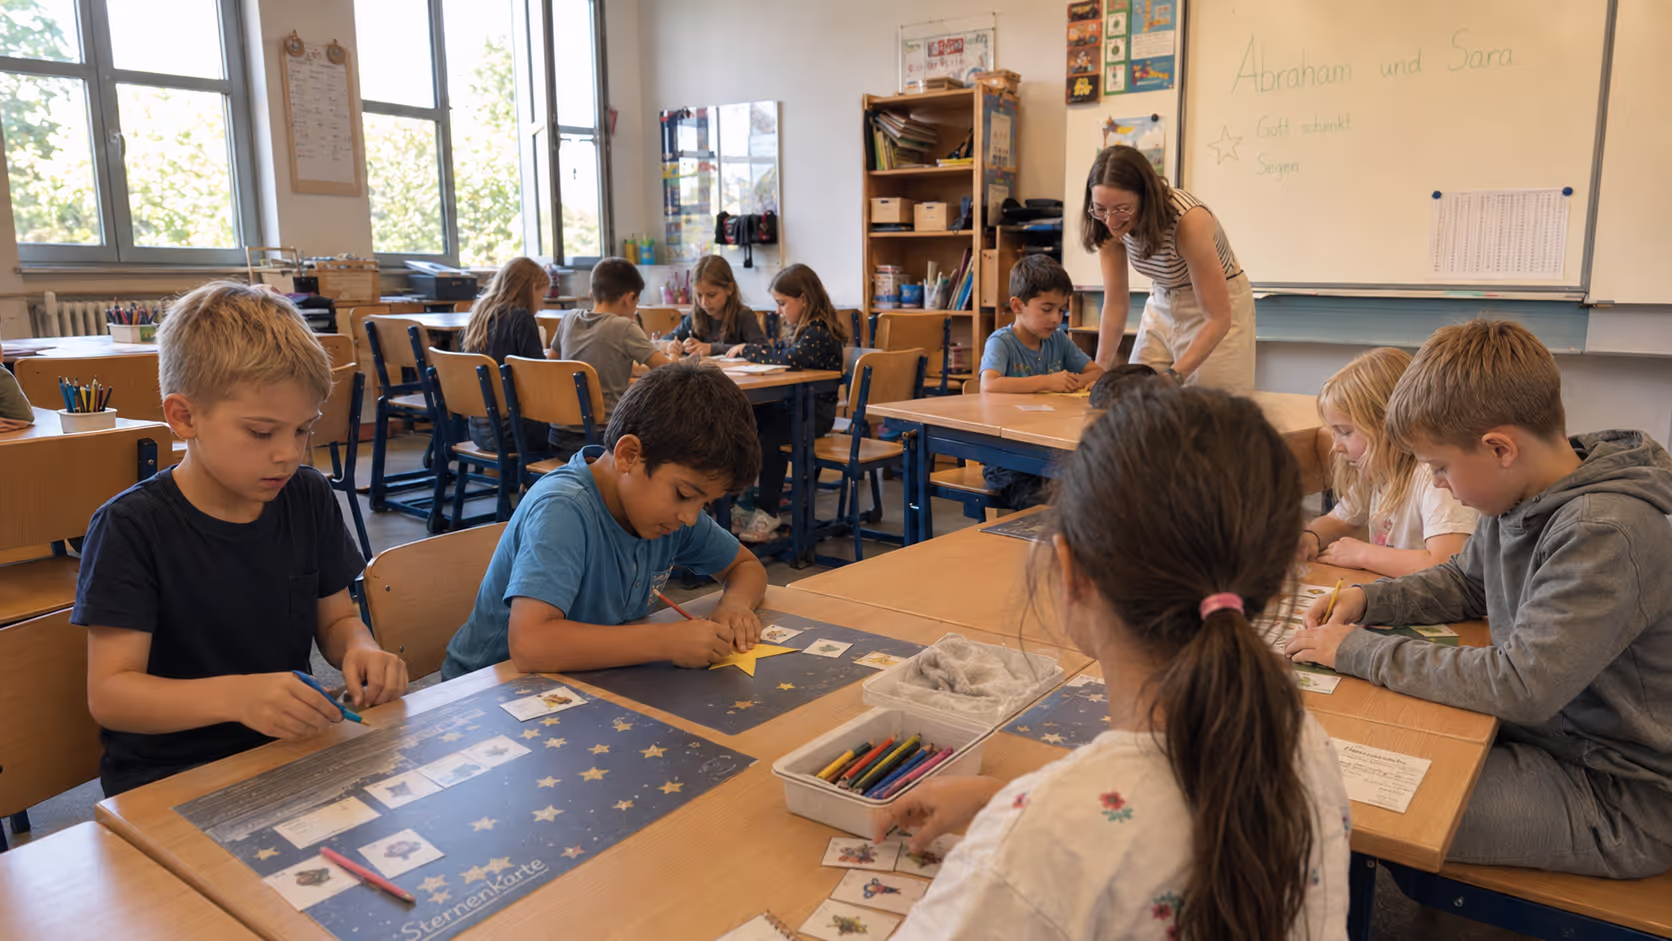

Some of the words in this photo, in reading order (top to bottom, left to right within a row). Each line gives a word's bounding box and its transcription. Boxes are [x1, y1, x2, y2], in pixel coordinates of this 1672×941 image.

[1231, 33, 1352, 93] Abraham
[1380, 47, 1422, 78] und
[1447, 26, 1514, 71] Sara
[1256, 114, 1290, 138] Gott
